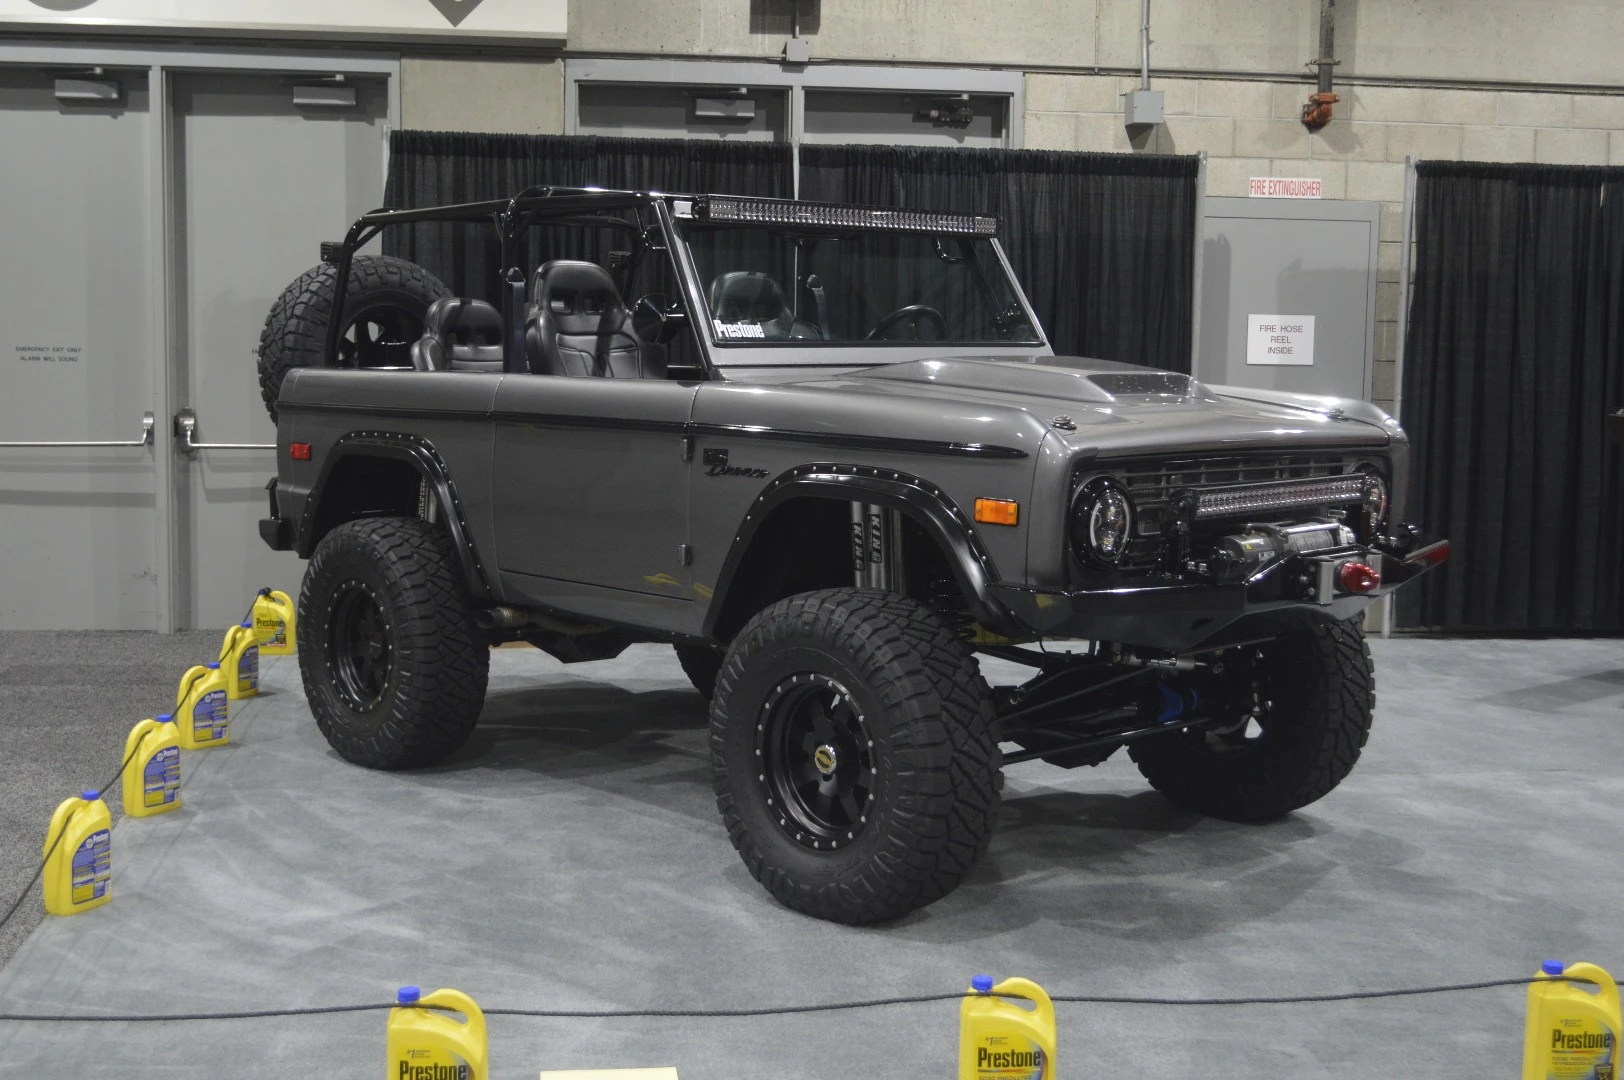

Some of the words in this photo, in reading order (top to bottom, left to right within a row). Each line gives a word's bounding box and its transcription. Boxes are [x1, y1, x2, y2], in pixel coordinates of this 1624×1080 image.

[1250, 180, 1266, 195] FIRE
[1268, 180, 1321, 197] EXTINGUISHER
[713, 319, 765, 338] Prestone
[1260, 325, 1277, 333] FIRE
[1280, 325, 1303, 333] HOSE
[1270, 335, 1292, 344] REEL
[1267, 346, 1293, 355] INSIDE
[1551, 1028, 1611, 1049] Prestone
[977, 1046, 1042, 1068] Prestone
[399, 1059, 467, 1080] Prestone
